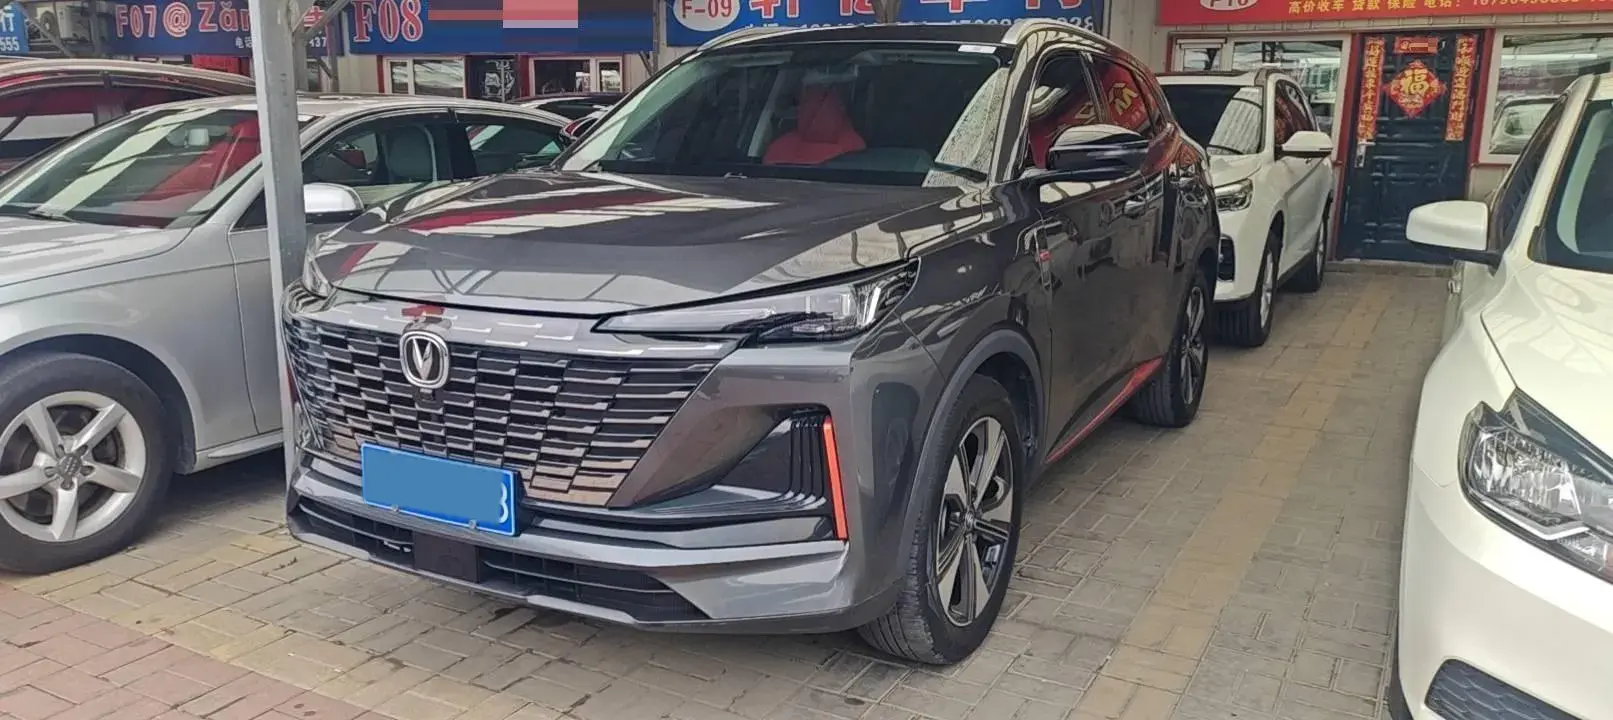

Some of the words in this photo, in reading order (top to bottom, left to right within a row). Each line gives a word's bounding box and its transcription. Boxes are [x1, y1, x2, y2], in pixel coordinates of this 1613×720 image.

[115, 4, 157, 38] F07
[681, 0, 732, 18] F-09
[1288, 0, 1345, 14] 高价收车
[353, 0, 424, 43] F08
[1400, 68, 1430, 96] 福
